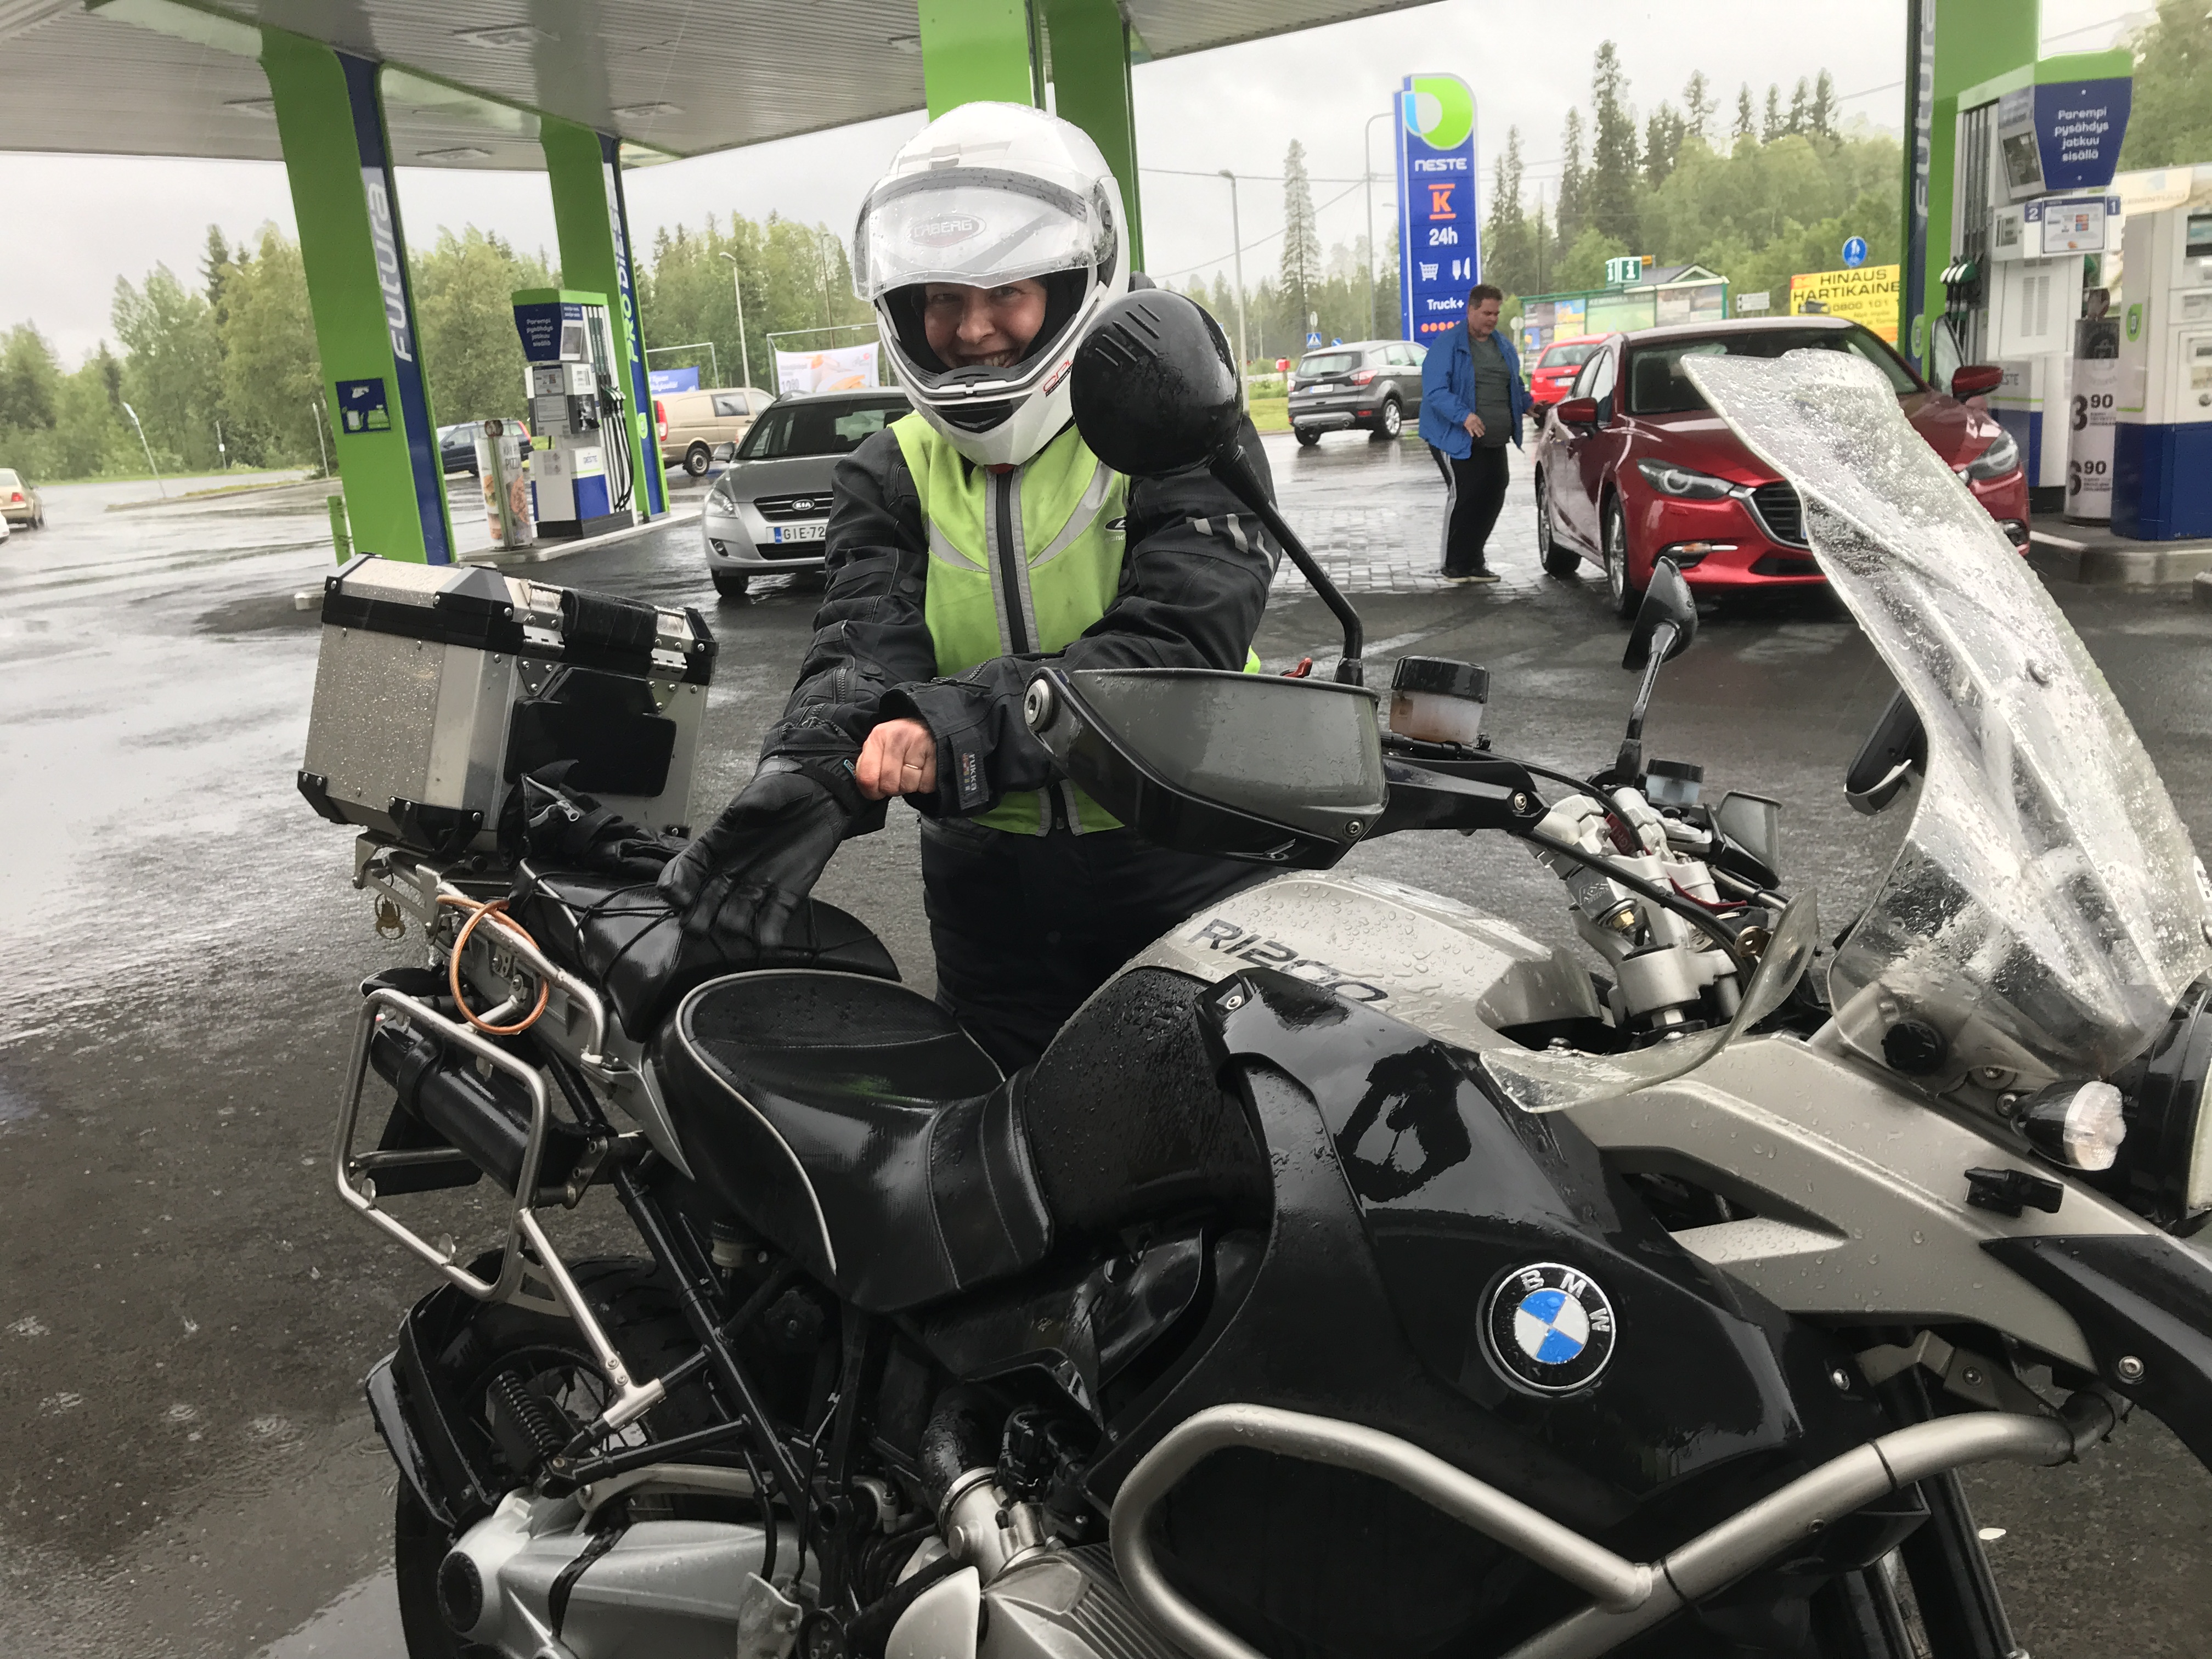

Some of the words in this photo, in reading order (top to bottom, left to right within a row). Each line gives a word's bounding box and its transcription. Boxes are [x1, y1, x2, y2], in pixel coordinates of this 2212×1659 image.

[2058, 105, 2107, 120] Parempi
[1414, 157, 1468, 172] NESTE
[1432, 190, 1452, 212] K
[2111, 202, 2117, 213] 1
[2028, 208, 2039, 220] 2
[913, 219, 973, 238] CABERG
[1429, 226, 1458, 246] 24h
[1820, 269, 1887, 285] HINAUS
[1426, 297, 1464, 311] Truck+
[1832, 301, 1863, 312] 0800
[620, 294, 639, 363] PRO
[2091, 393, 2113, 409] 90
[2084, 460, 2107, 475] 90
[1520, 1269, 1610, 1333] BMW
